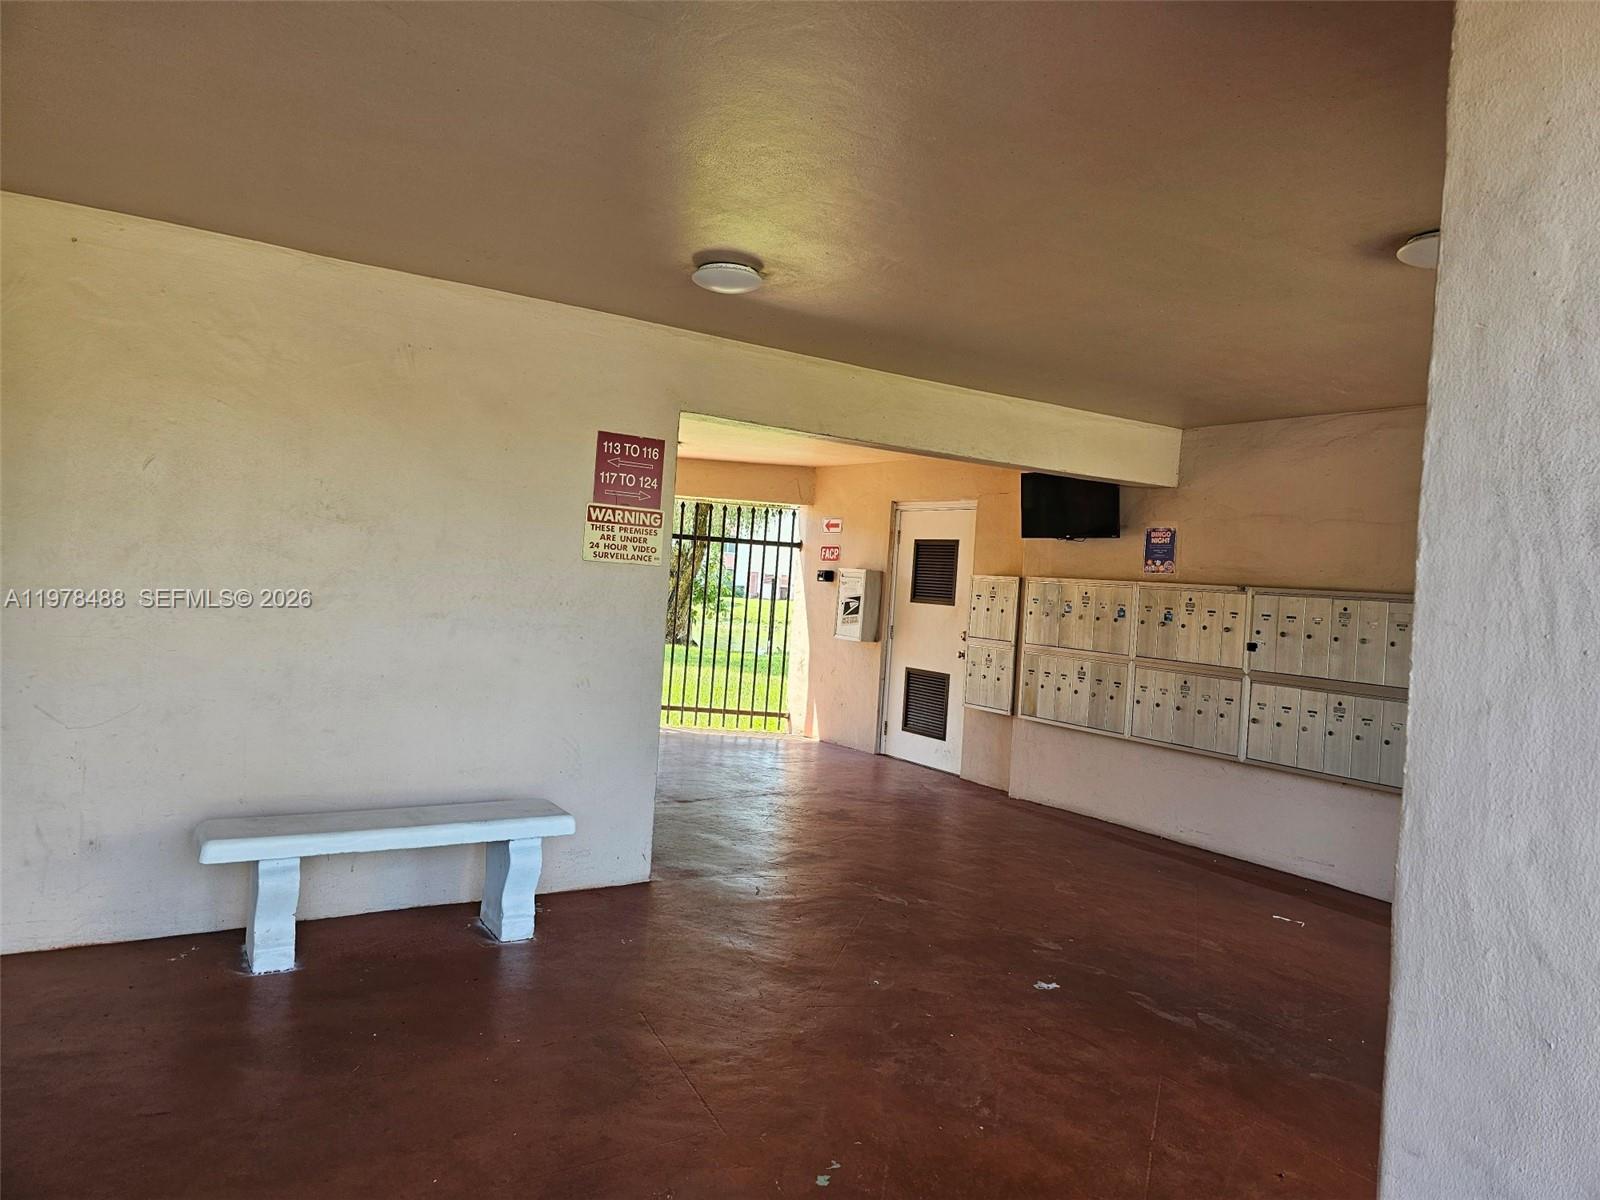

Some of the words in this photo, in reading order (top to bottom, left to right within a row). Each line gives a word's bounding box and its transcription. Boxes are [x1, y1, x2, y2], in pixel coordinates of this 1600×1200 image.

[603, 441, 621, 455] 113
[624, 443, 640, 457] TO
[642, 446, 659, 460] 116
[600, 471, 618, 484] 117
[619, 473, 636, 487] TO
[639, 476, 658, 489] 124
[589, 506, 662, 527] WARNING
[591, 523, 615, 533] THESE
[619, 526, 658, 536] PREMISES
[600, 533, 616, 542] ARE
[620, 536, 648, 545] UNDER
[589, 541, 600, 549] 24
[603, 542, 628, 552] HOUR
[632, 545, 657, 554] VIDEO
[821, 548, 839, 560] FACP
[592, 551, 652, 562] SURVEILLANCE
